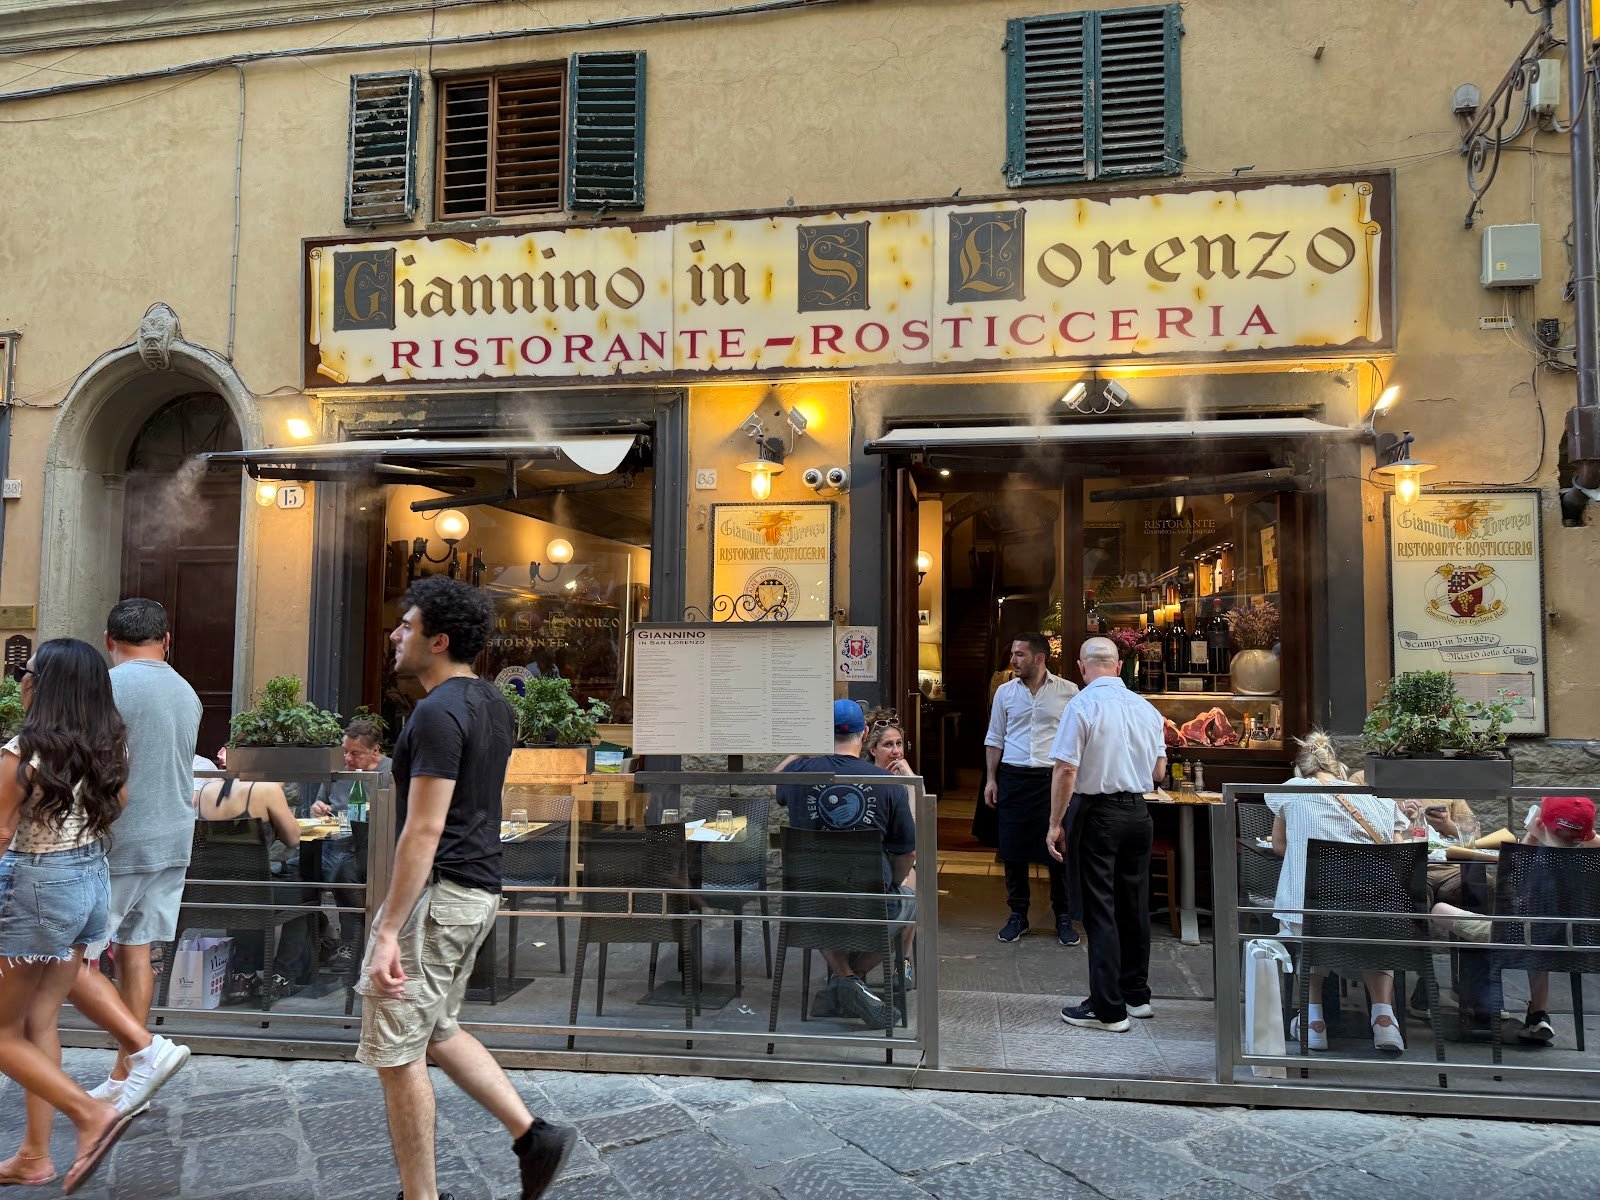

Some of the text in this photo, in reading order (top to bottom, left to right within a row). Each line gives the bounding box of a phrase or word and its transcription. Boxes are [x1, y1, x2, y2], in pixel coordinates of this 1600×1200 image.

[338, 211, 1357, 325] Giannino in S Lorenzo
[391, 328, 747, 369] RISTORANTE
[809, 304, 1279, 355] ROSTICCERIA
[1144, 519, 1216, 529] RISTORANTE
[1397, 508, 1457, 540] Giannino
[1397, 541, 1533, 558] RISTORANTE ROSTICCERIA
[486, 637, 566, 648] STORANTE
[638, 631, 706, 639] GIANNINO
[862, 796, 878, 825] CLUB
